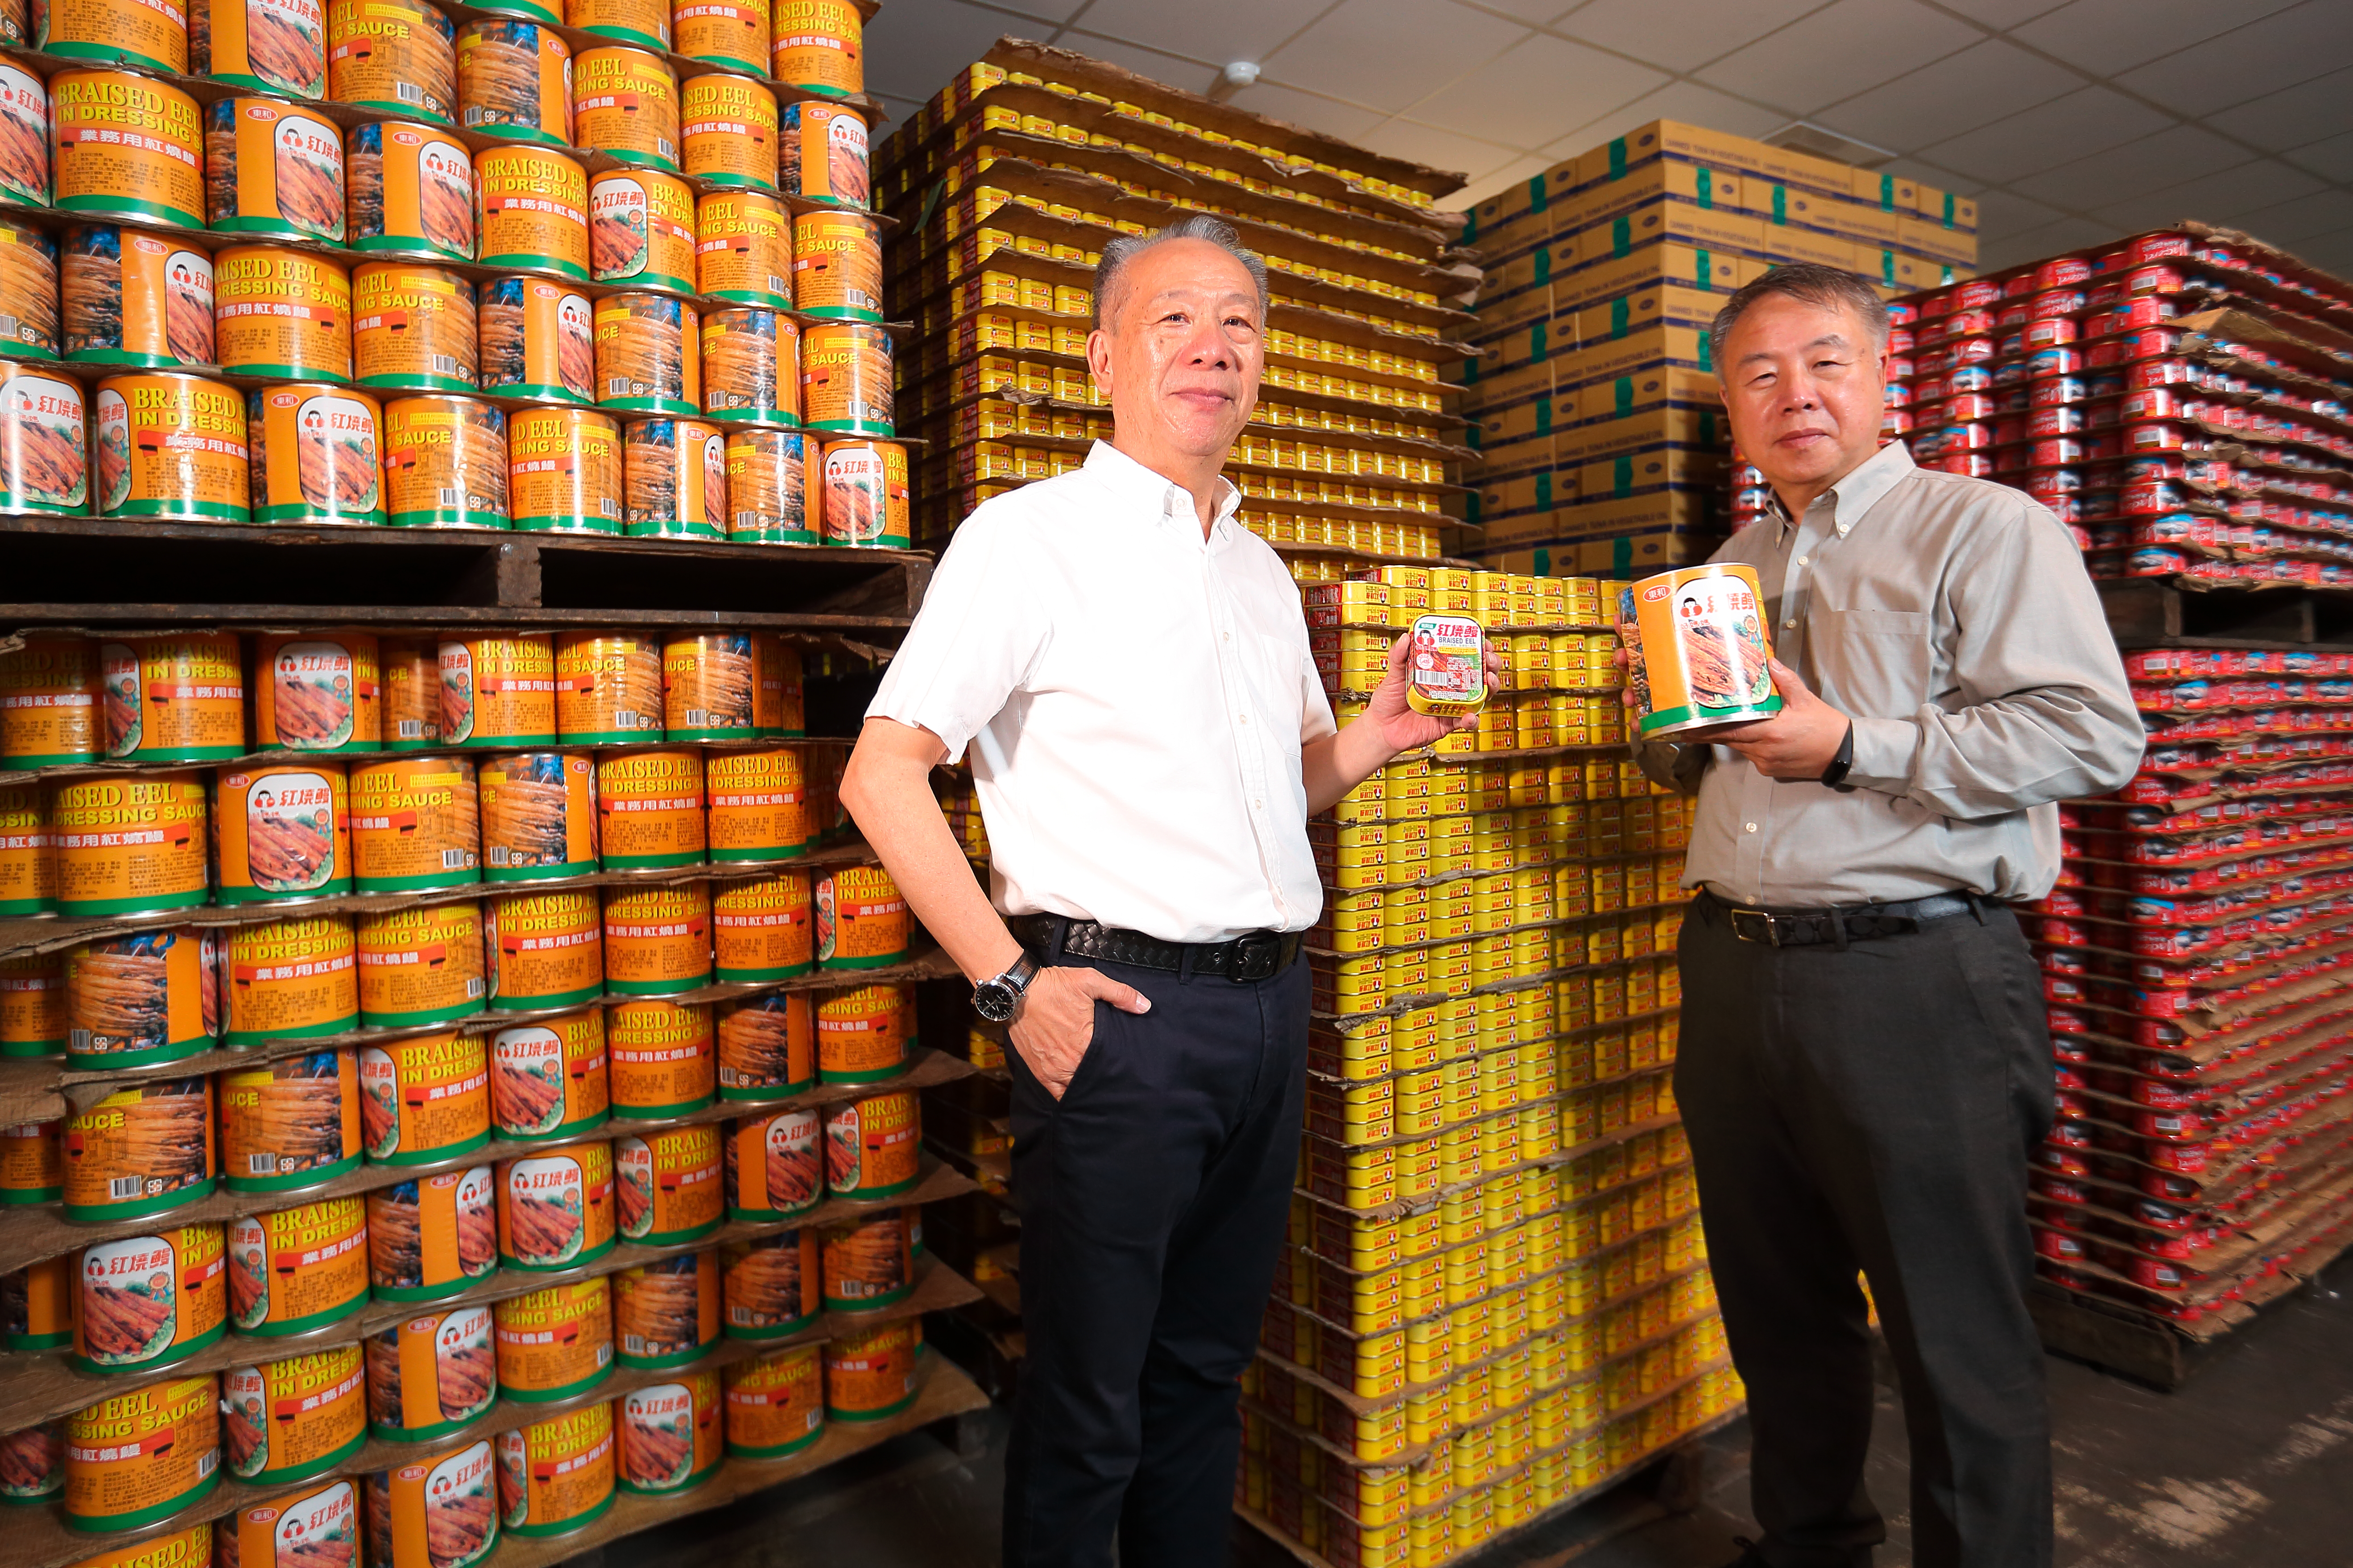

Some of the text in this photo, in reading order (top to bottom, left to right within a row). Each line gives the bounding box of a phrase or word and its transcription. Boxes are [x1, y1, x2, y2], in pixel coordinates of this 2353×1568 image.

[819, 2, 848, 25] EEL
[347, 22, 410, 40] SAUCE
[591, 58, 626, 76] EEL
[614, 78, 667, 101] SAUCE
[721, 85, 756, 108] EEL
[58, 81, 201, 133] BRAISED EEL
[252, 109, 272, 120] 東和
[59, 107, 190, 143] IN DRESSING
[80, 129, 196, 167] 業務用紅燒鰻
[484, 158, 568, 185] BRAISED
[485, 179, 586, 207] IN DRESSING
[604, 190, 644, 209] 紅燒鰻
[653, 202, 670, 217] IN
[702, 203, 739, 221] EEL
[728, 221, 777, 239] SAUCE
[803, 240, 857, 253] SAUCE
[283, 259, 324, 288] EEL
[360, 273, 394, 294] EEL
[380, 294, 445, 312] SAUCE
[810, 352, 858, 366] SAUCE
[37, 395, 83, 422] 紅燒鰻
[133, 388, 237, 418] BRAISED
[135, 411, 158, 426] IN
[395, 431, 452, 445] SAUCE
[529, 421, 568, 440] EEL
[555, 441, 609, 458] SAUCE
[888, 470, 899, 481] IN
[1648, 587, 1667, 599] 東和
[1436, 624, 1478, 637] 紅燒鰻
[147, 644, 236, 664] BRAISED
[476, 640, 550, 660] BRAISED
[558, 642, 583, 659] EEL
[147, 665, 169, 679] IN
[300, 655, 349, 672] 紅燒鰻
[478, 660, 496, 673] IN
[572, 658, 627, 673] SAUCE
[600, 759, 700, 779] BRAISED EEL
[773, 755, 799, 772] EEL
[364, 773, 403, 793] EEL
[614, 779, 692, 793] DRESSING
[715, 775, 790, 789] DRESSING
[128, 782, 178, 804] EEL
[279, 787, 329, 806] 紅燒鰻
[389, 792, 453, 807] SAUCE
[839, 888, 855, 900] IN
[500, 895, 583, 918] BRAISED
[607, 905, 684, 919] DRESSING
[389, 909, 432, 929] EEL
[501, 909, 597, 932] IN DRESSING
[419, 921, 473, 942] SAUCE
[233, 937, 349, 961] IN DRESSING
[674, 1007, 704, 1026] EEL
[614, 1027, 692, 1044] DRESSING
[568, 1044, 585, 1057] IN
[402, 1069, 423, 1084] IN
[658, 1155, 679, 1170] IN
[587, 1170, 601, 1184] IN
[273, 1234, 294, 1249] IN
[109, 1248, 171, 1275] 紅燒鰻
[182, 1250, 203, 1266] IN
[272, 1381, 296, 1397] IN
[105, 1391, 158, 1421] EEL
[140, 1390, 209, 1429] SAUCE
[531, 1444, 552, 1459] IN
